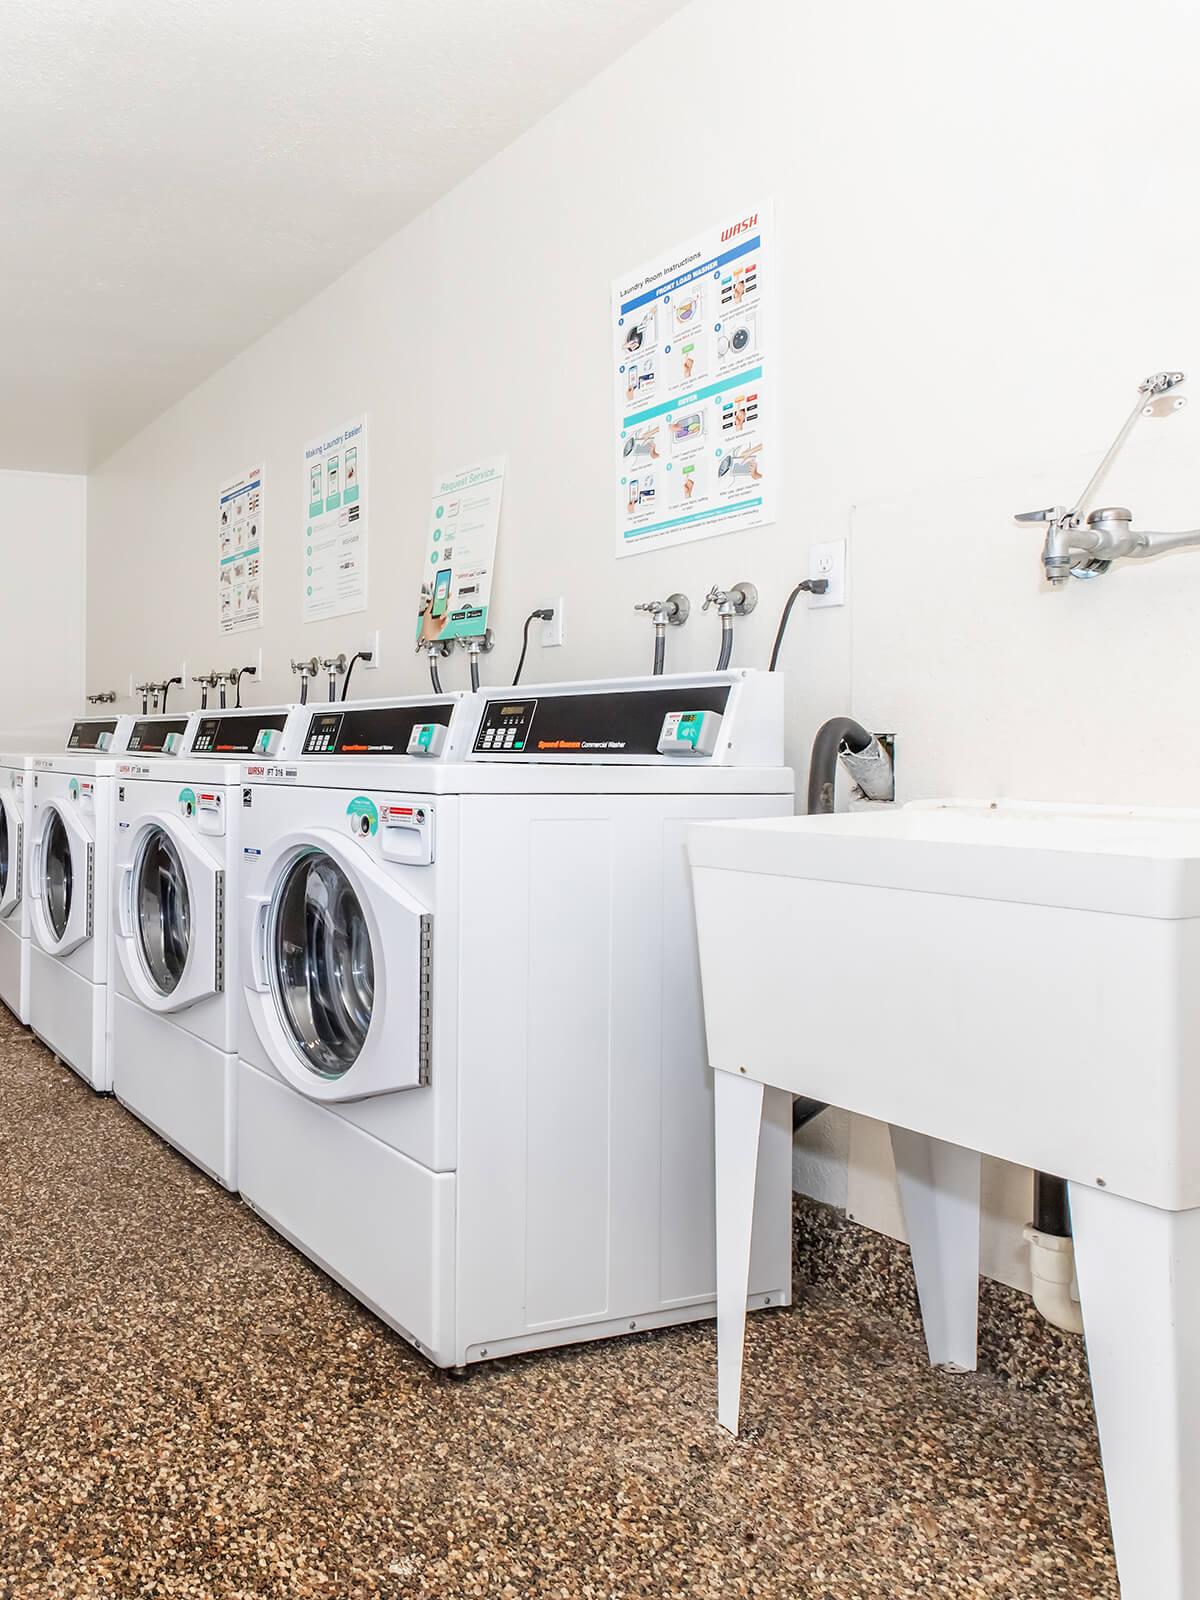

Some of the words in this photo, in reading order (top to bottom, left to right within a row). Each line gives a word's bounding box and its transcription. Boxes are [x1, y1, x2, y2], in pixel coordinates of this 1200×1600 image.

[721, 213, 758, 242] WASH
[620, 281, 643, 297] Laundry
[644, 272, 662, 284] Room
[664, 252, 701, 275] Instructions
[305, 446, 322, 459] Making
[323, 436, 344, 450] Laundry
[440, 476, 467, 493] Request
[469, 468, 495, 483] Service
[248, 767, 264, 776] WASH
